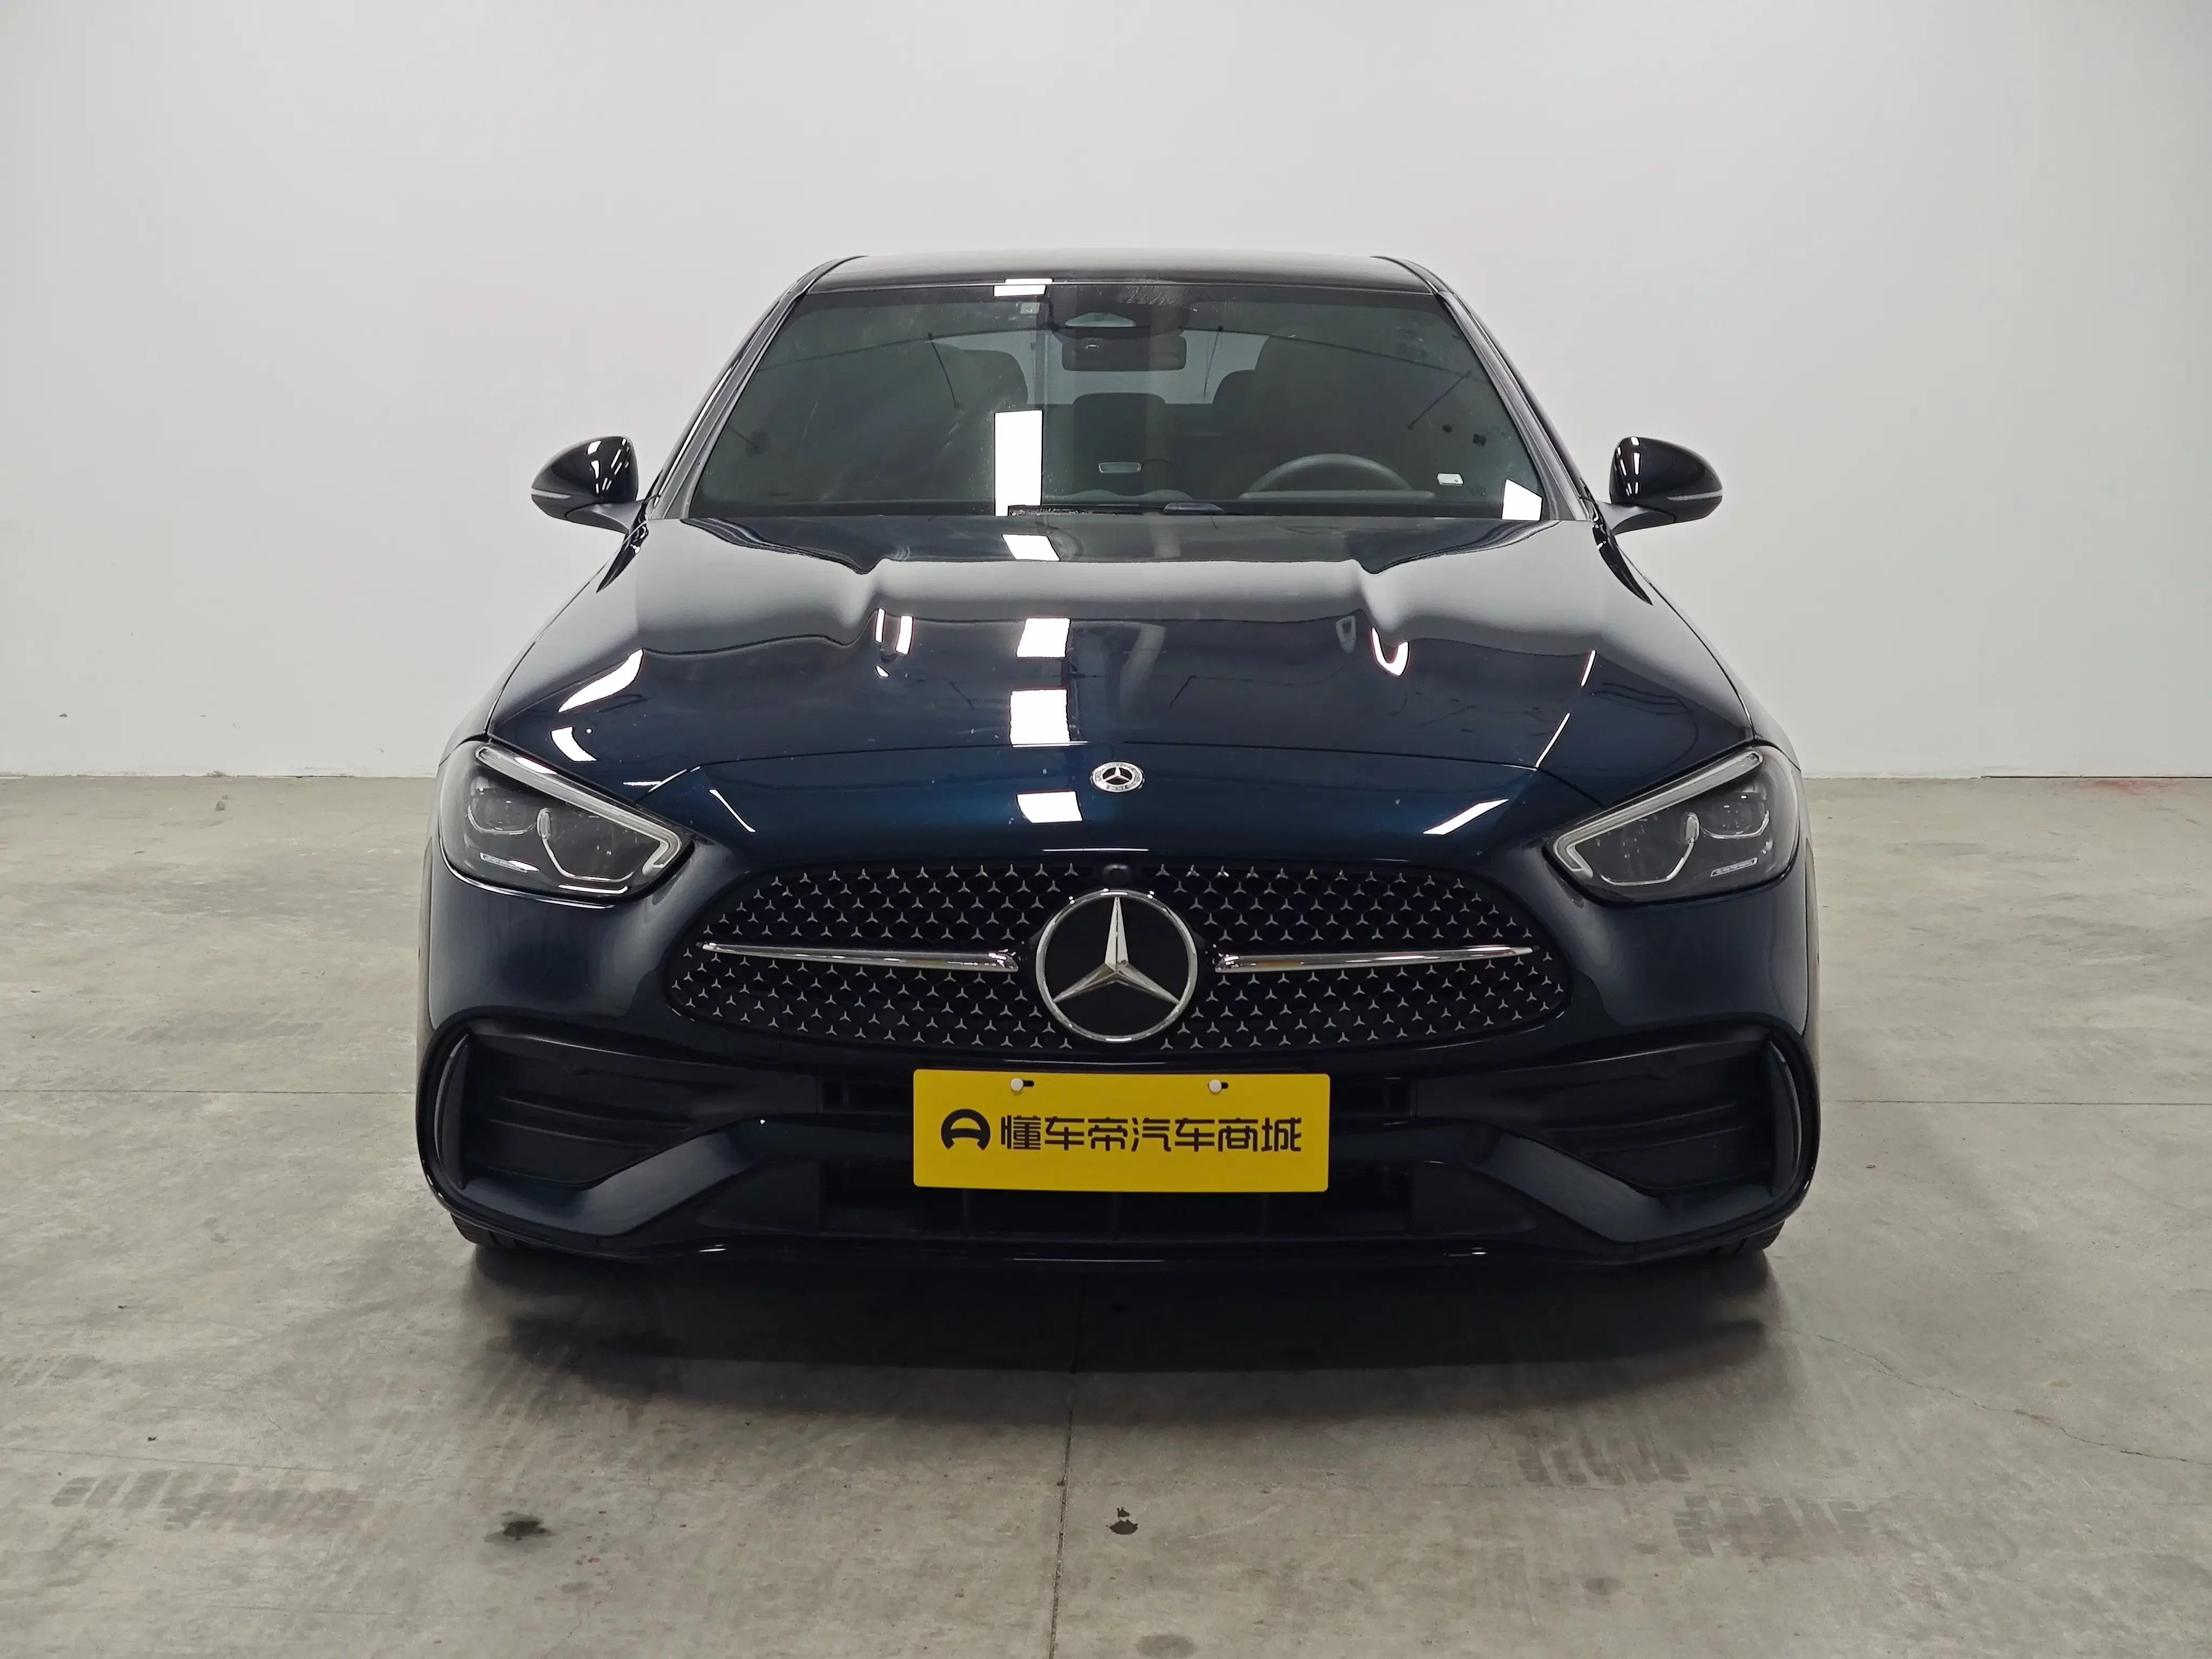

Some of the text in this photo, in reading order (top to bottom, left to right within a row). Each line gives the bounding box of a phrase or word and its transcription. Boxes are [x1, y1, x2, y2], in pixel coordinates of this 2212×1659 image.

[1000, 1115, 1302, 1152] 懂车帝汽车商城
